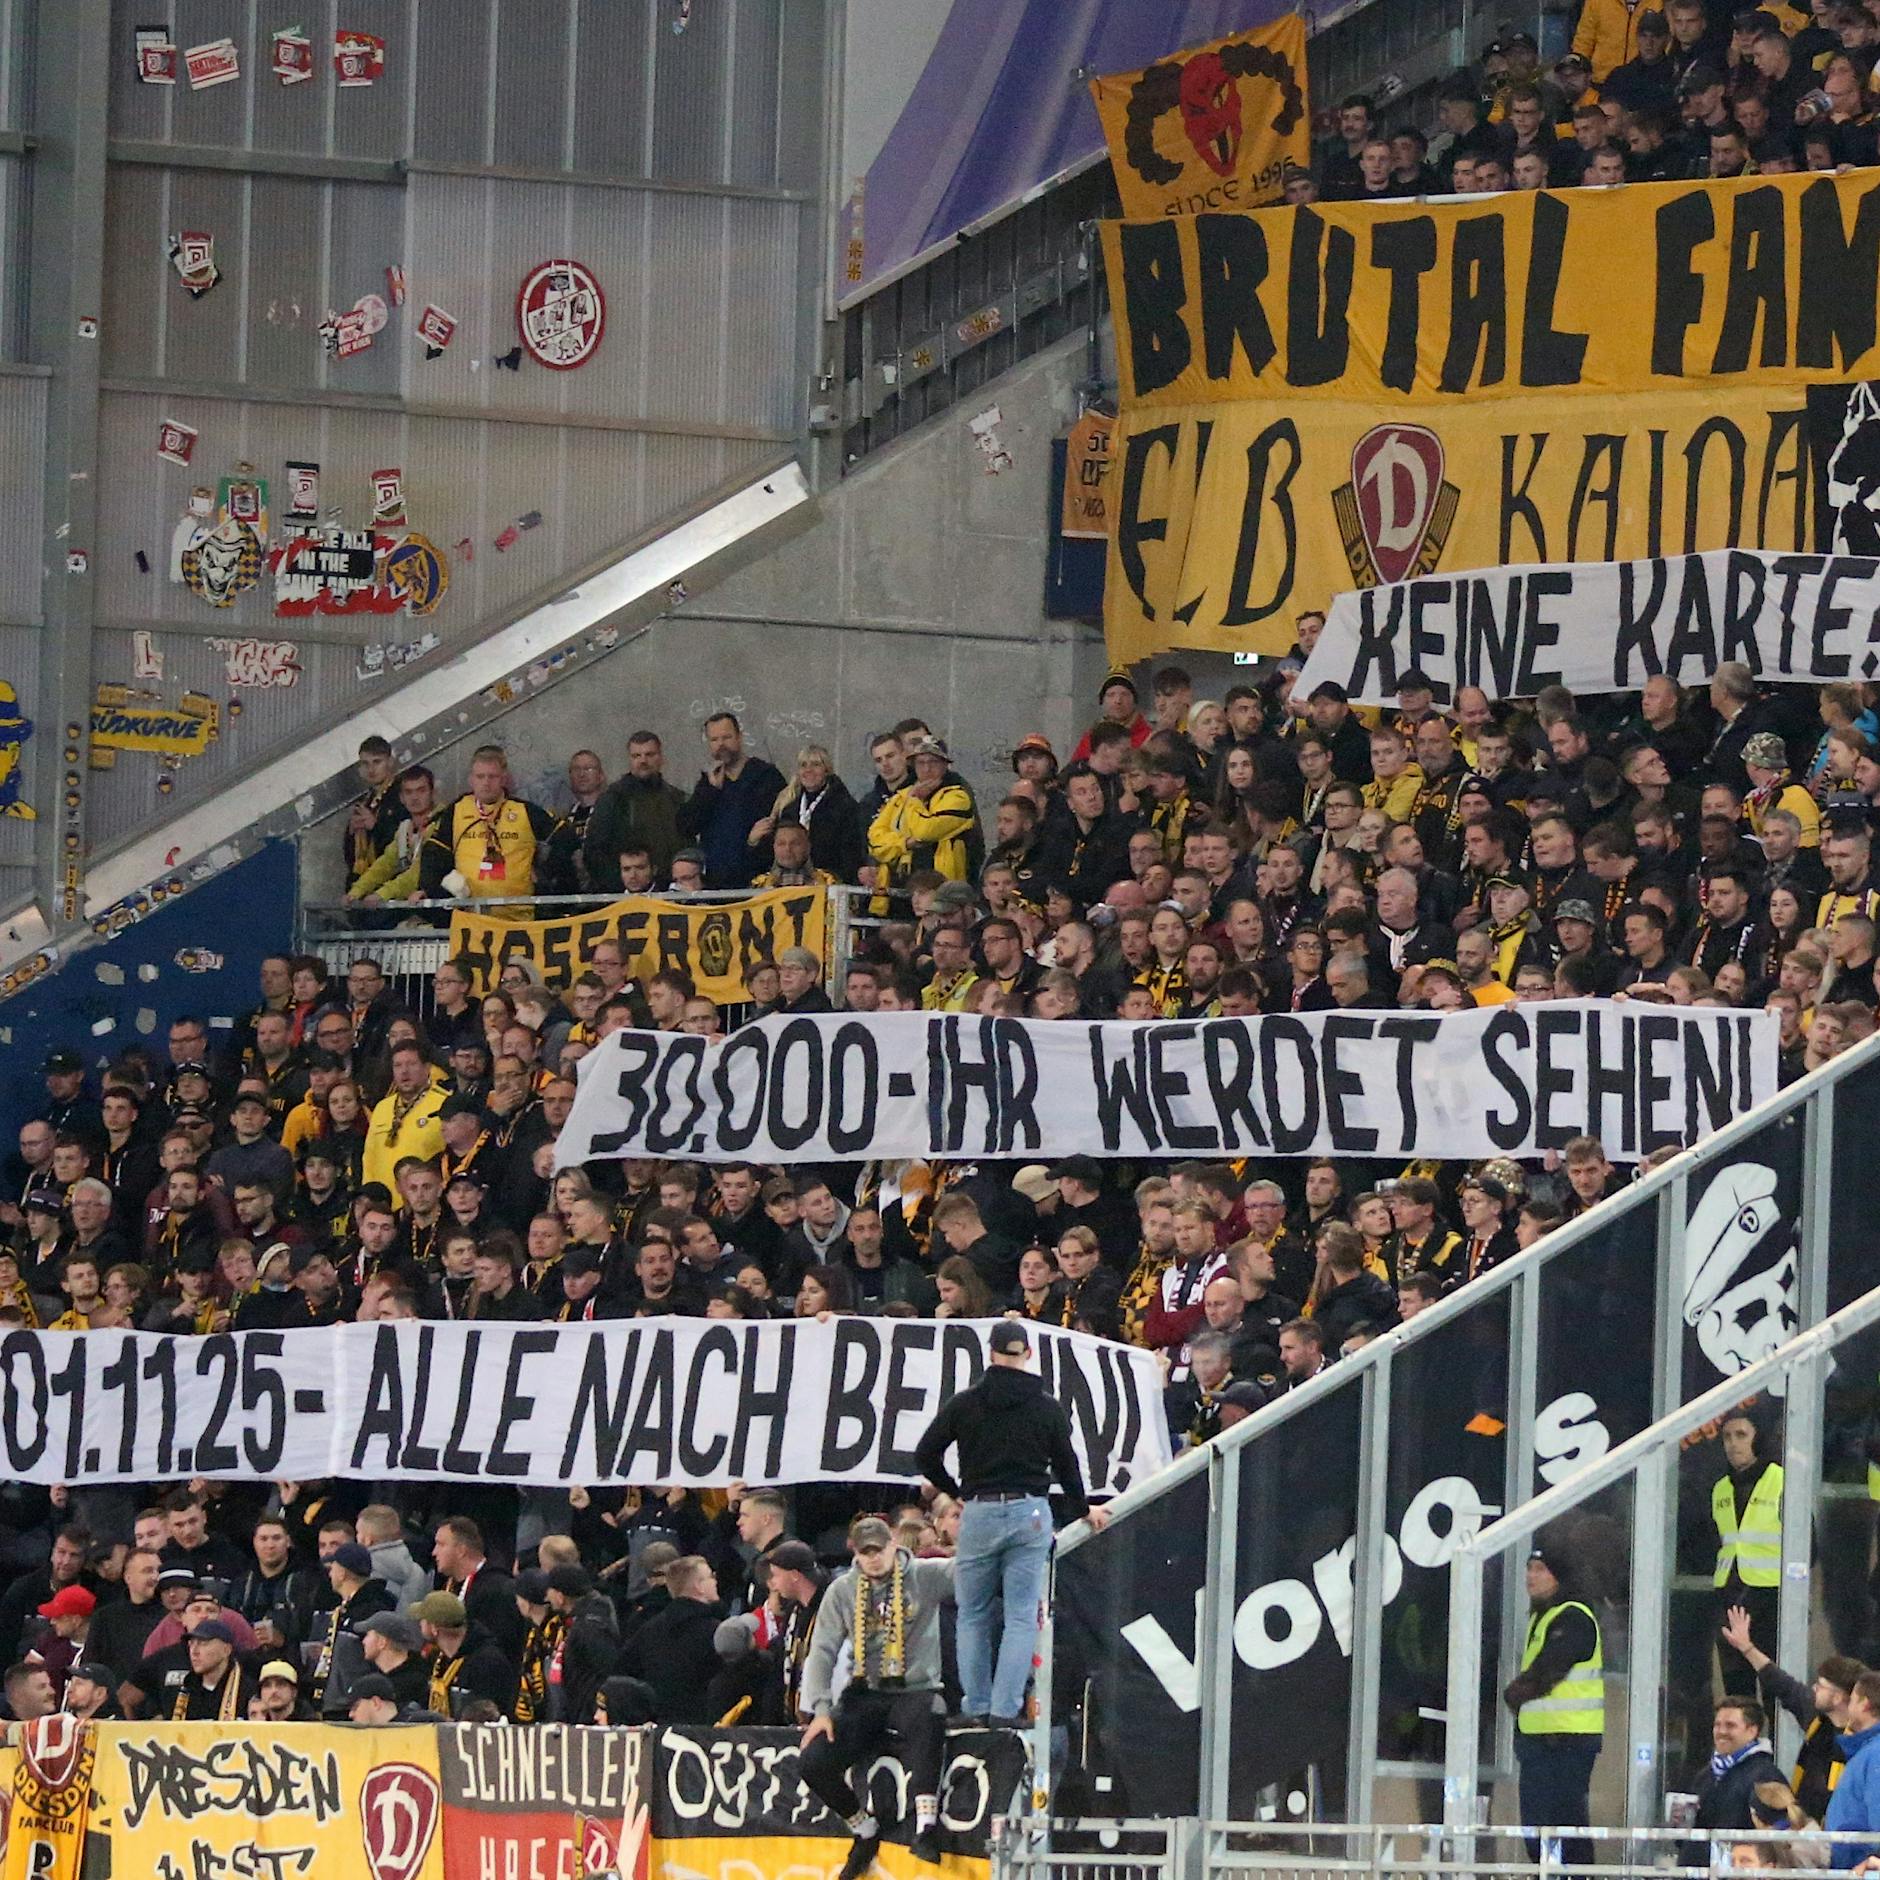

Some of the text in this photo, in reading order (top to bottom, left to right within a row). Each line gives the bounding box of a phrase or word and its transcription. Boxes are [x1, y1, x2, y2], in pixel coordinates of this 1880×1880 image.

[1120, 191, 1589, 397] BRUTAL
[319, 552, 349, 573] THE
[1347, 572, 1572, 705] KEINE
[1089, 1015, 1440, 1154] WERDET
[1481, 1010, 1752, 1153] SEHEN!
[352, 1324, 559, 1476] ALLE
[559, 1324, 796, 1480] NACH
[119, 1739, 340, 1827] DRESDEN
[457, 1722, 642, 1807] SCHNELLER
